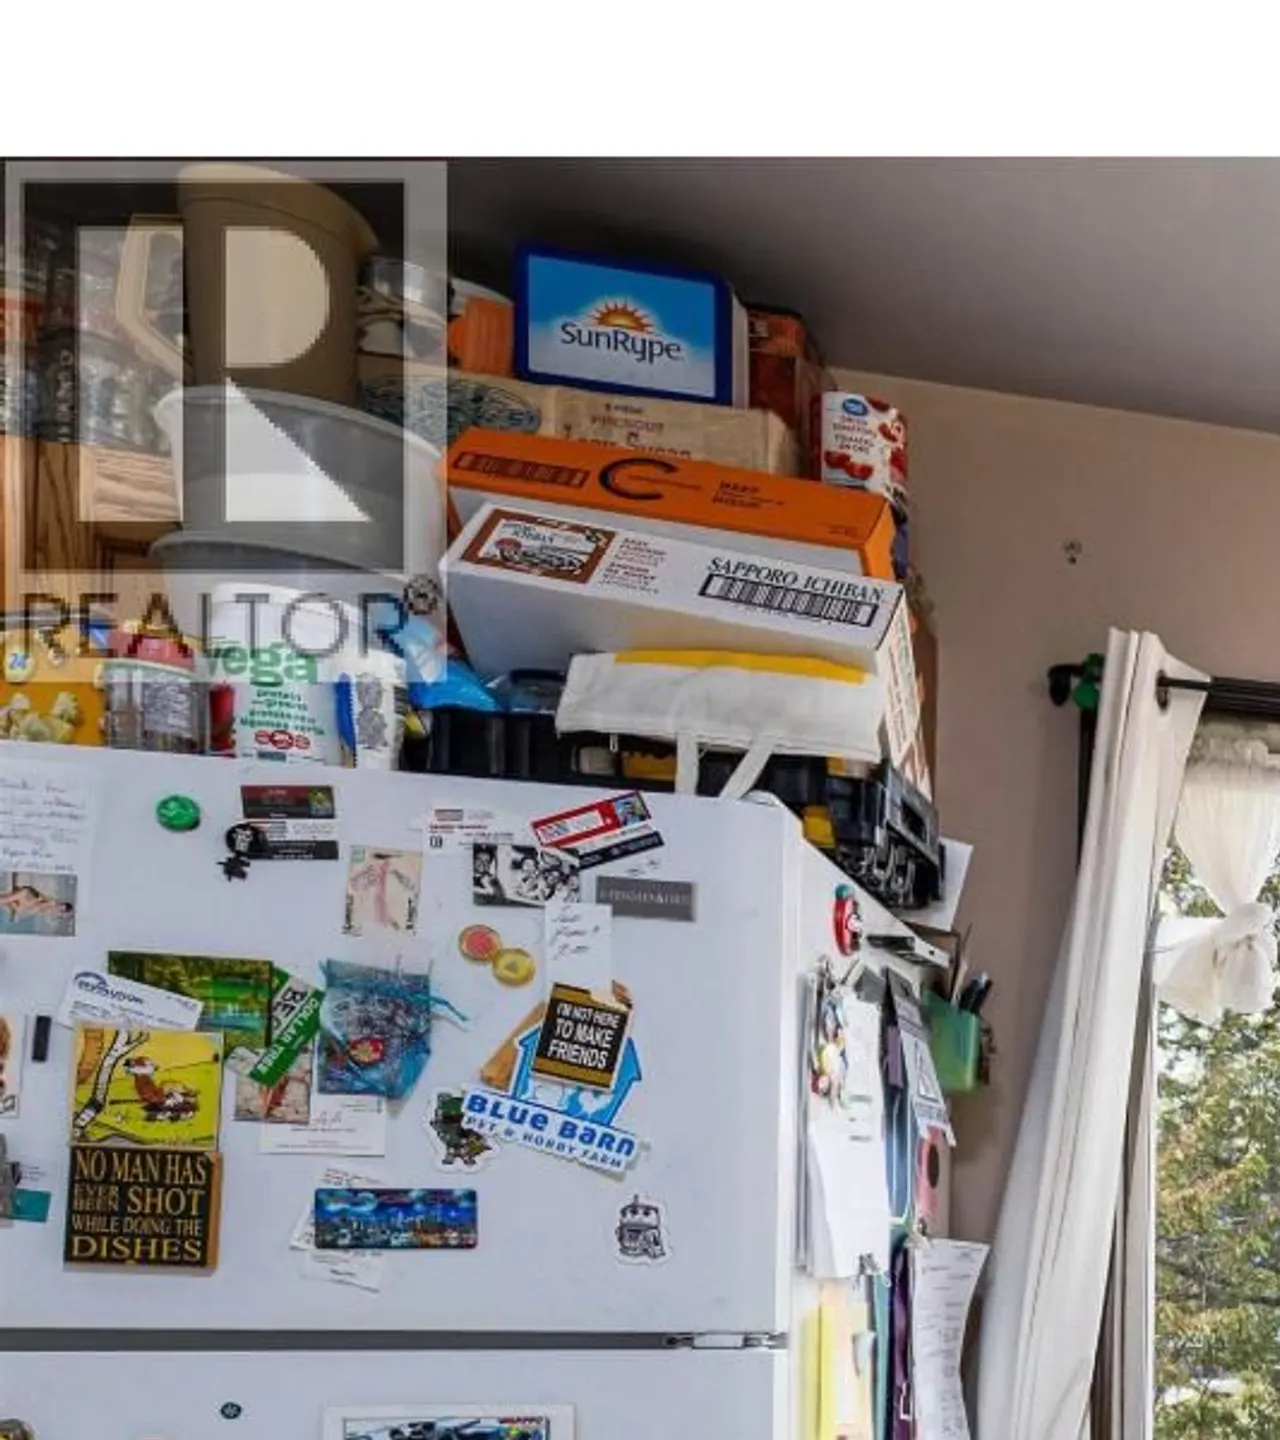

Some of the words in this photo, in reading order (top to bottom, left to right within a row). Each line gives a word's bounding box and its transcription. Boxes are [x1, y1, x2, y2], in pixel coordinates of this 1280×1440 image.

[561, 321, 684, 363] SunRype
[708, 556, 799, 587] SAPPORO
[802, 575, 884, 601] ICHIBAN
[206, 642, 318, 687] vega
[555, 1018, 575, 1038] TO
[576, 1023, 614, 1048] MAKE
[593, 1009, 621, 1028] HERE
[548, 1039, 609, 1069] FRIENDS
[522, 1131, 577, 1156] HOBBY
[580, 1149, 623, 1168] FARM
[74, 1150, 107, 1181] NO
[111, 1152, 161, 1183] MAN
[165, 1154, 207, 1185] HAS
[73, 1183, 119, 1198] EVER
[73, 1197, 119, 1212] BEEN
[127, 1185, 206, 1216] SHOT
[71, 1214, 120, 1233] WHILE
[122, 1216, 171, 1236] DOING
[176, 1218, 202, 1237] THE
[72, 1235, 201, 1261] DISHES
